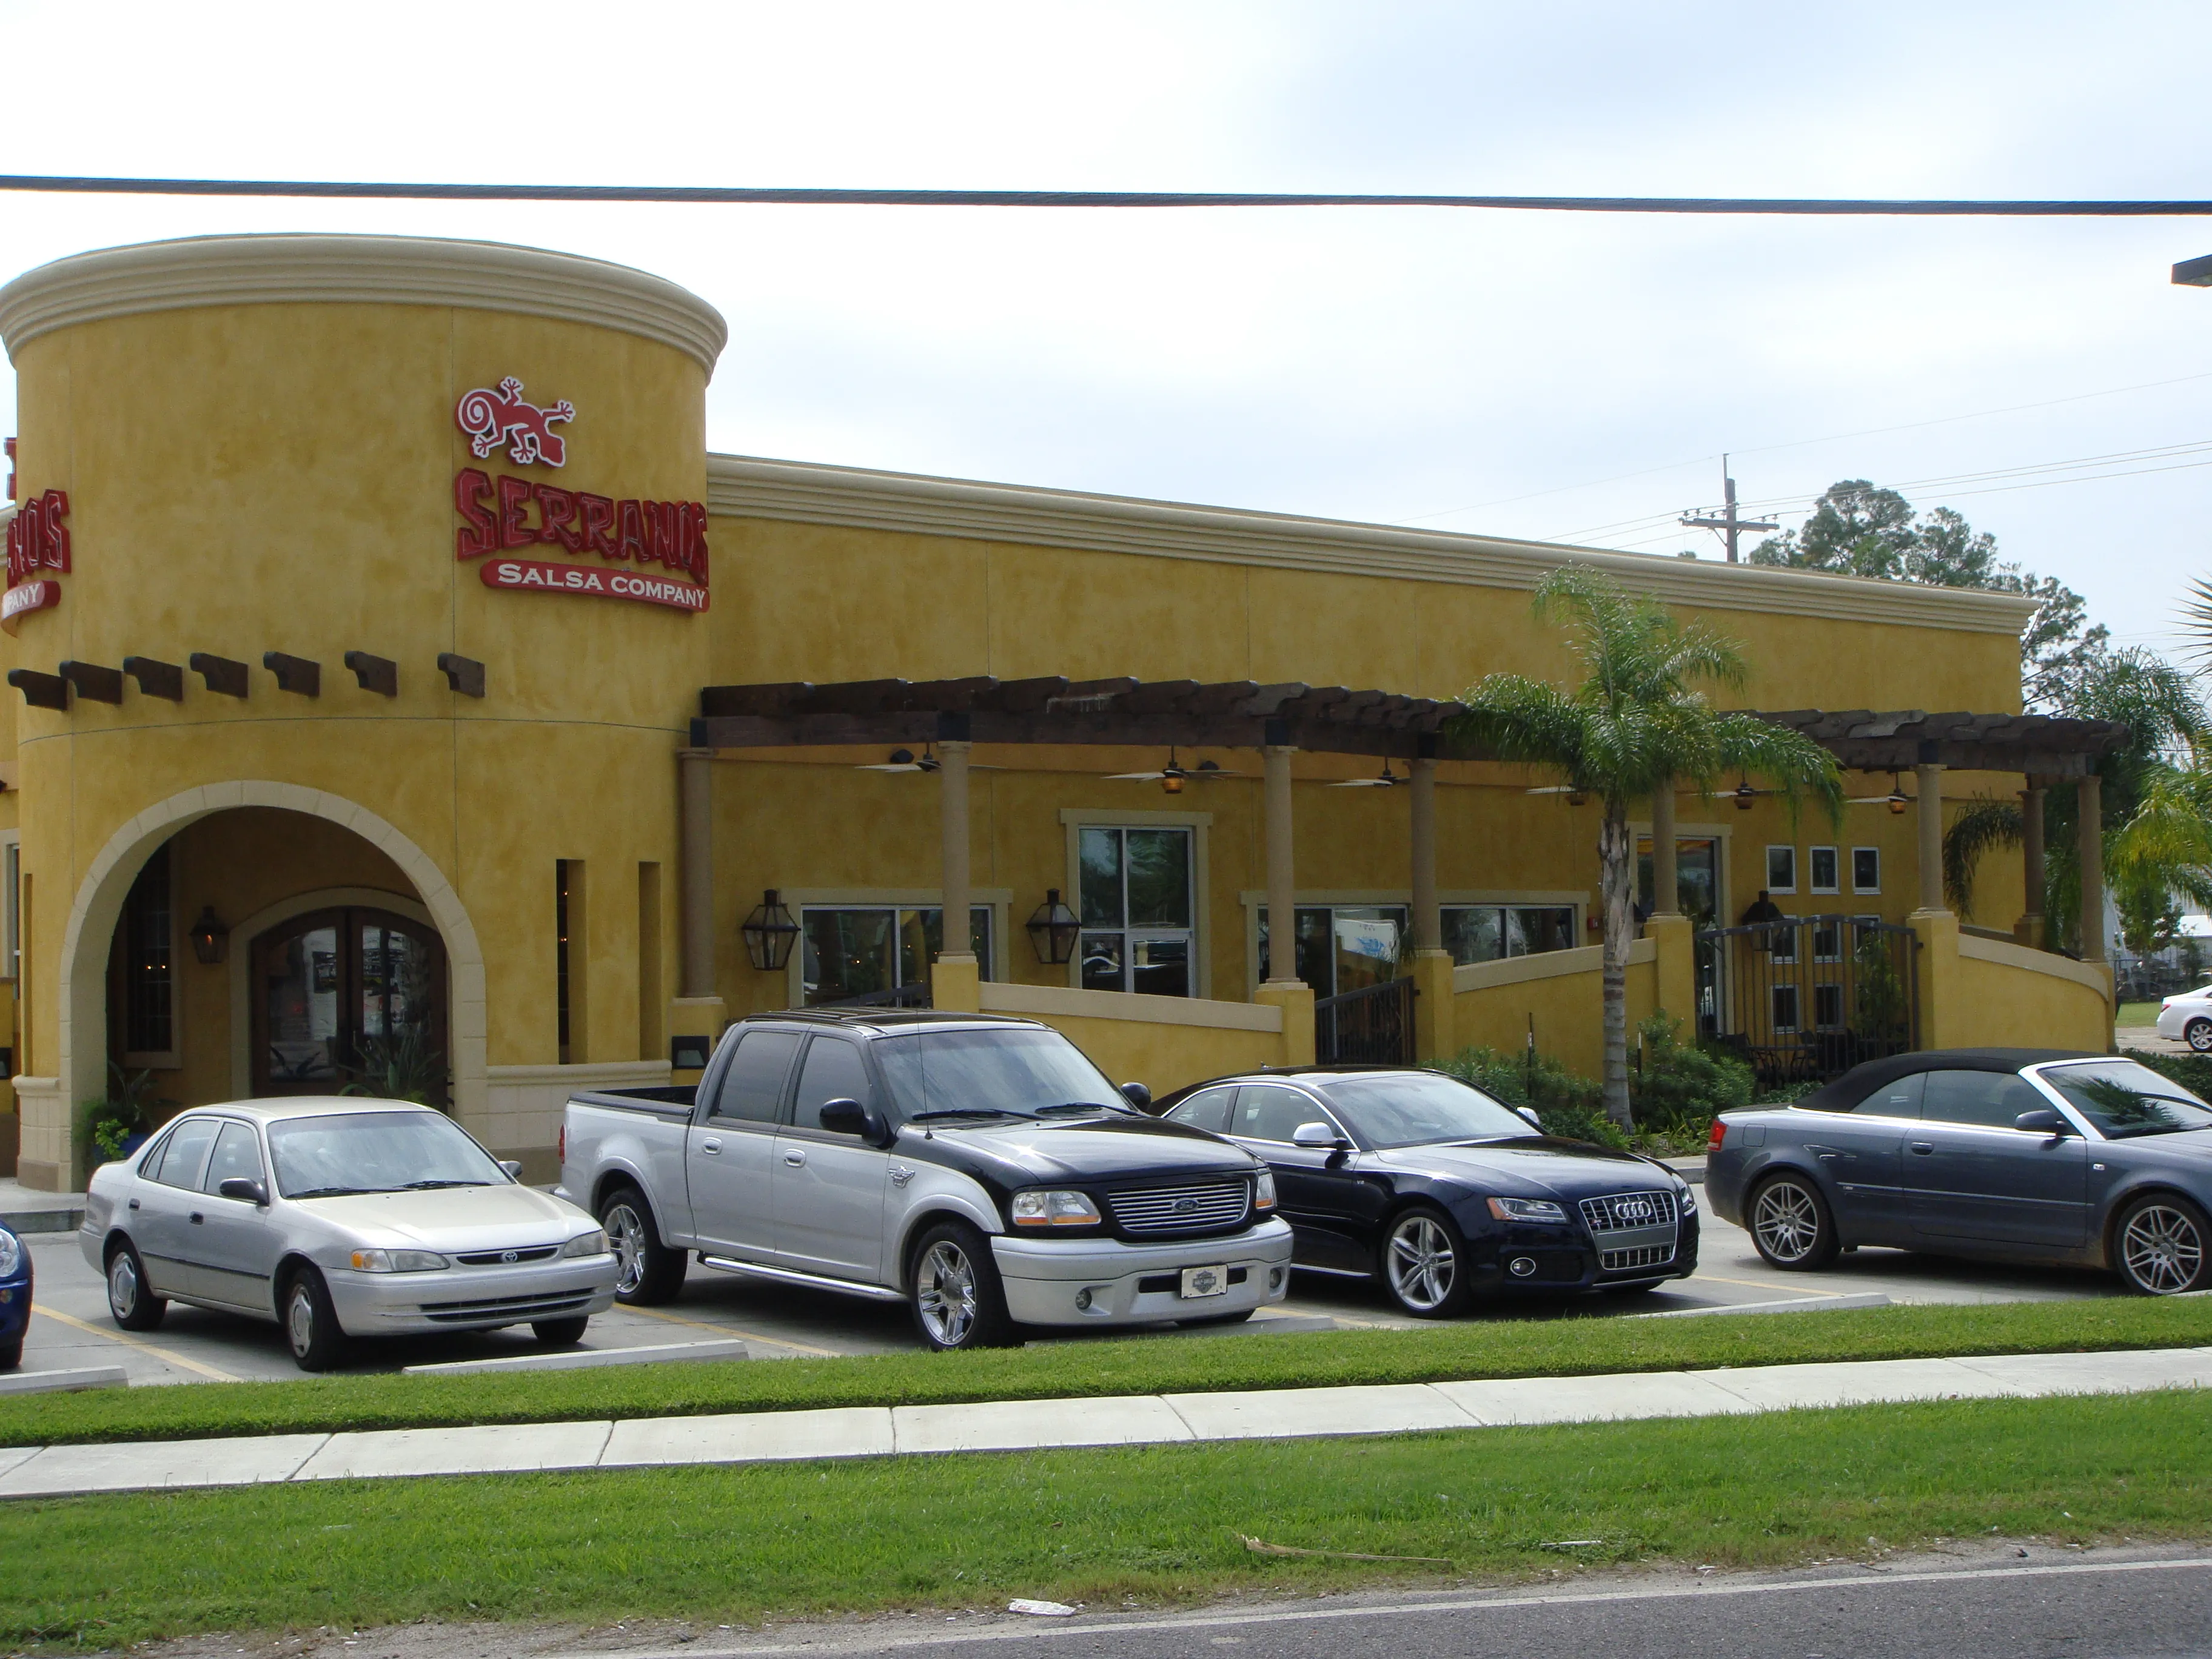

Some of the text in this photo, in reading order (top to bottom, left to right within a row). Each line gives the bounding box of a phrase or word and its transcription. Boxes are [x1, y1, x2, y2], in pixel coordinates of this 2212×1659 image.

[4, 583, 41, 614] PANY
[497, 563, 706, 609] SALSA COMPANY
